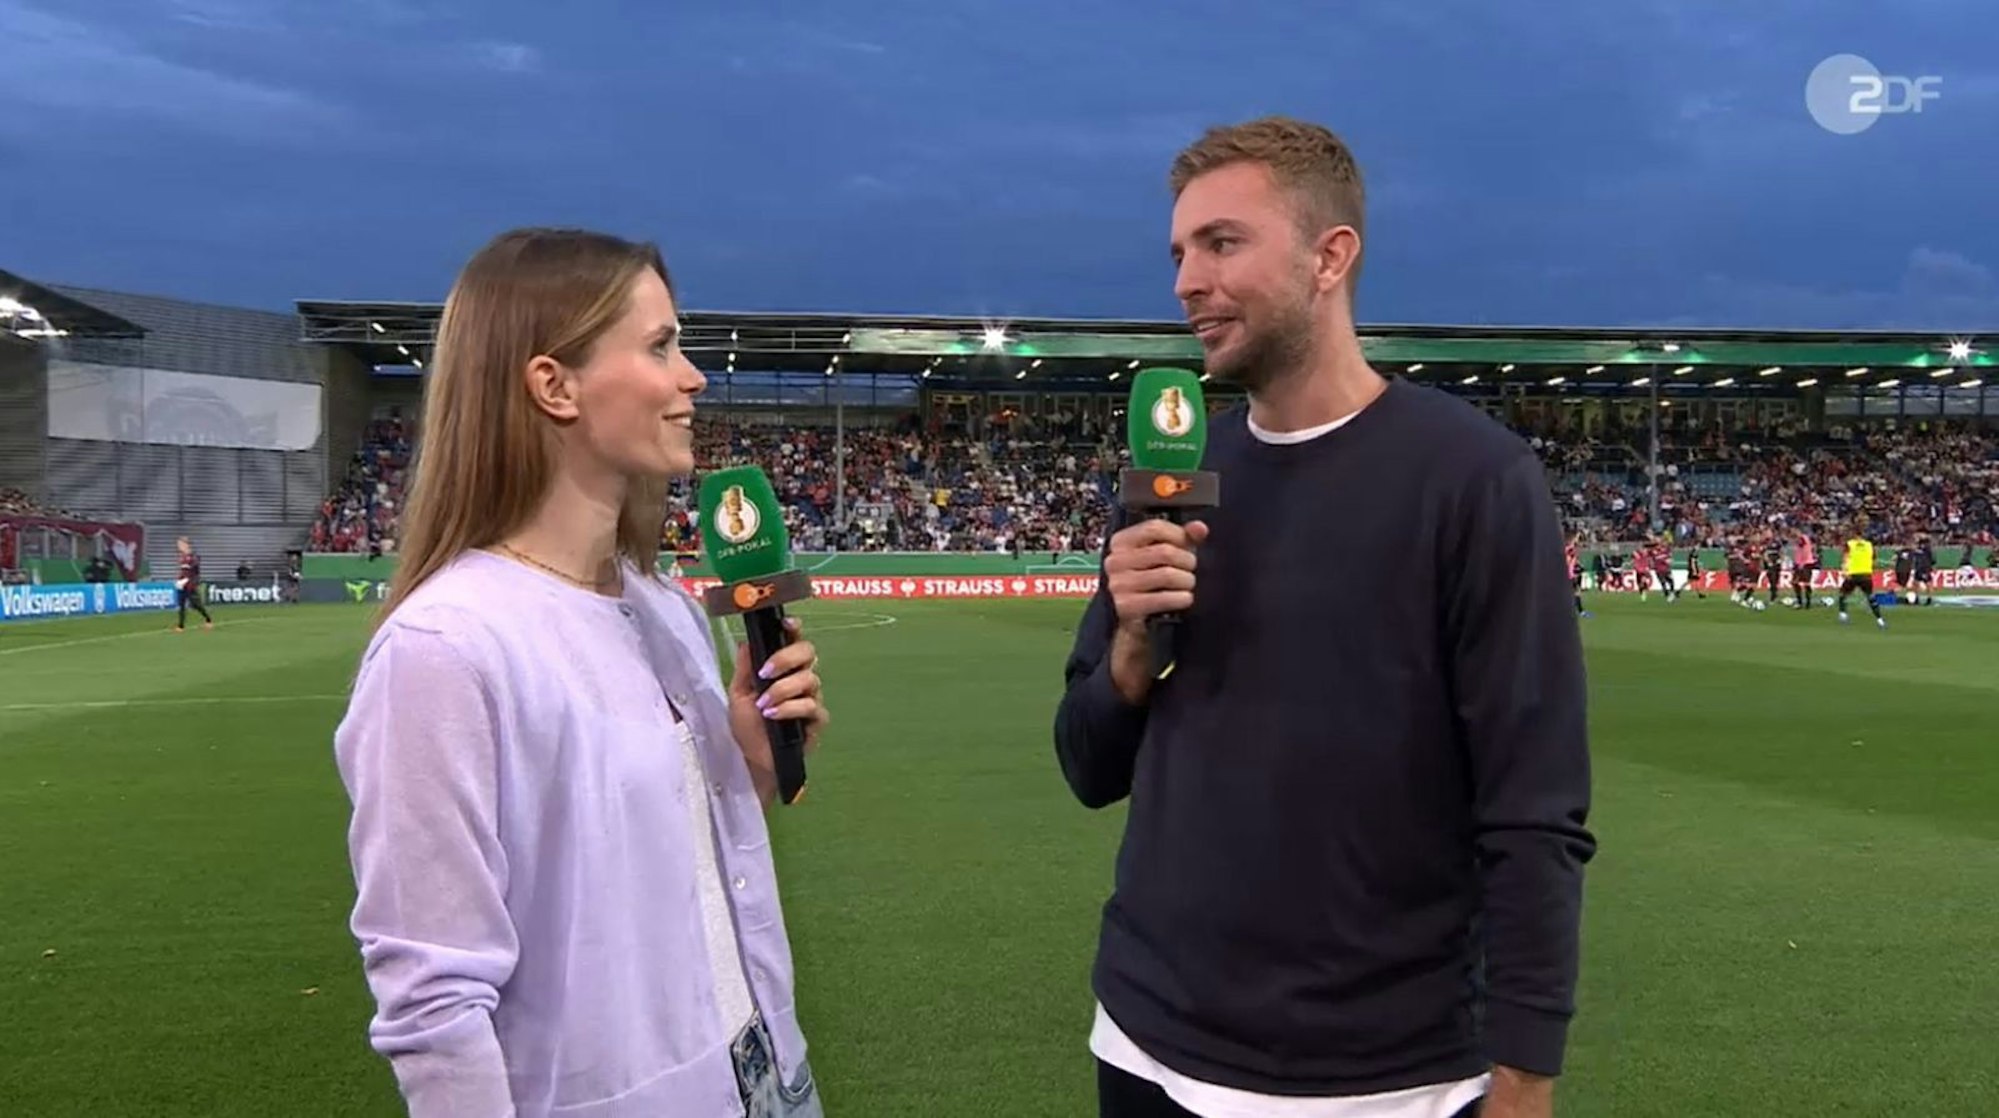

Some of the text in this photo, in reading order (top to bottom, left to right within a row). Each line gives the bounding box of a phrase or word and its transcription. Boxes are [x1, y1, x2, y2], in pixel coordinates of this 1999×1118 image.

[208, 584, 281, 602] freenet
[810, 579, 893, 595] STRAUSS
[924, 579, 1004, 594] STRAUSS
[1034, 578, 1100, 593] STRAUS
[1, 584, 85, 616] Volkswagen
[115, 582, 175, 609] Volkswagen
